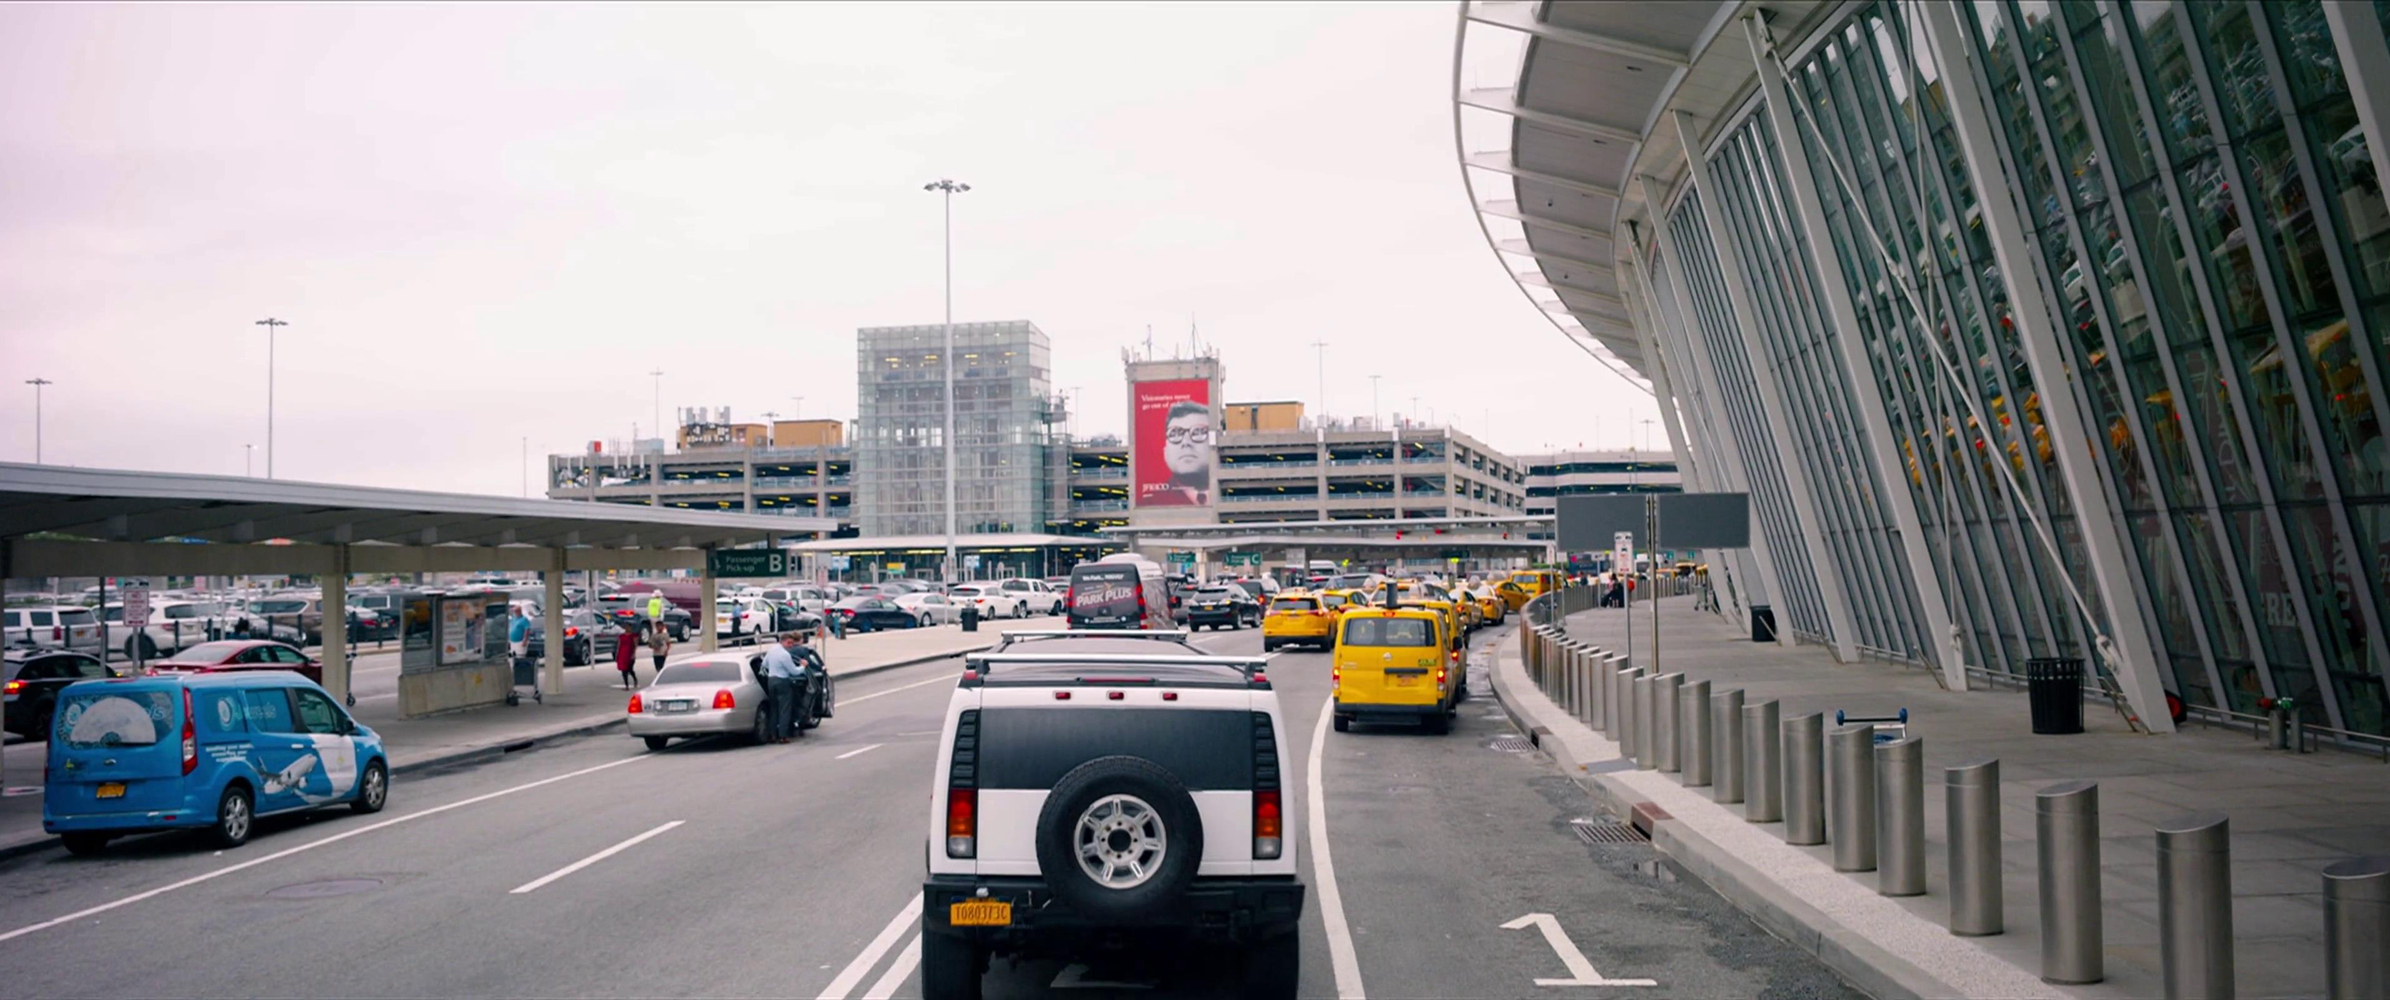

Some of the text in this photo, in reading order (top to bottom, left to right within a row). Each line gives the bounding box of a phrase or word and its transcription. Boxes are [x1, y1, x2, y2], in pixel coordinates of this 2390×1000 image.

[725, 555, 765, 564] Passenger
[769, 554, 782, 572] B
[1251, 553, 1260, 564] C
[725, 564, 755, 572] Pick-up
[1076, 587, 1131, 607] PARK PLUS
